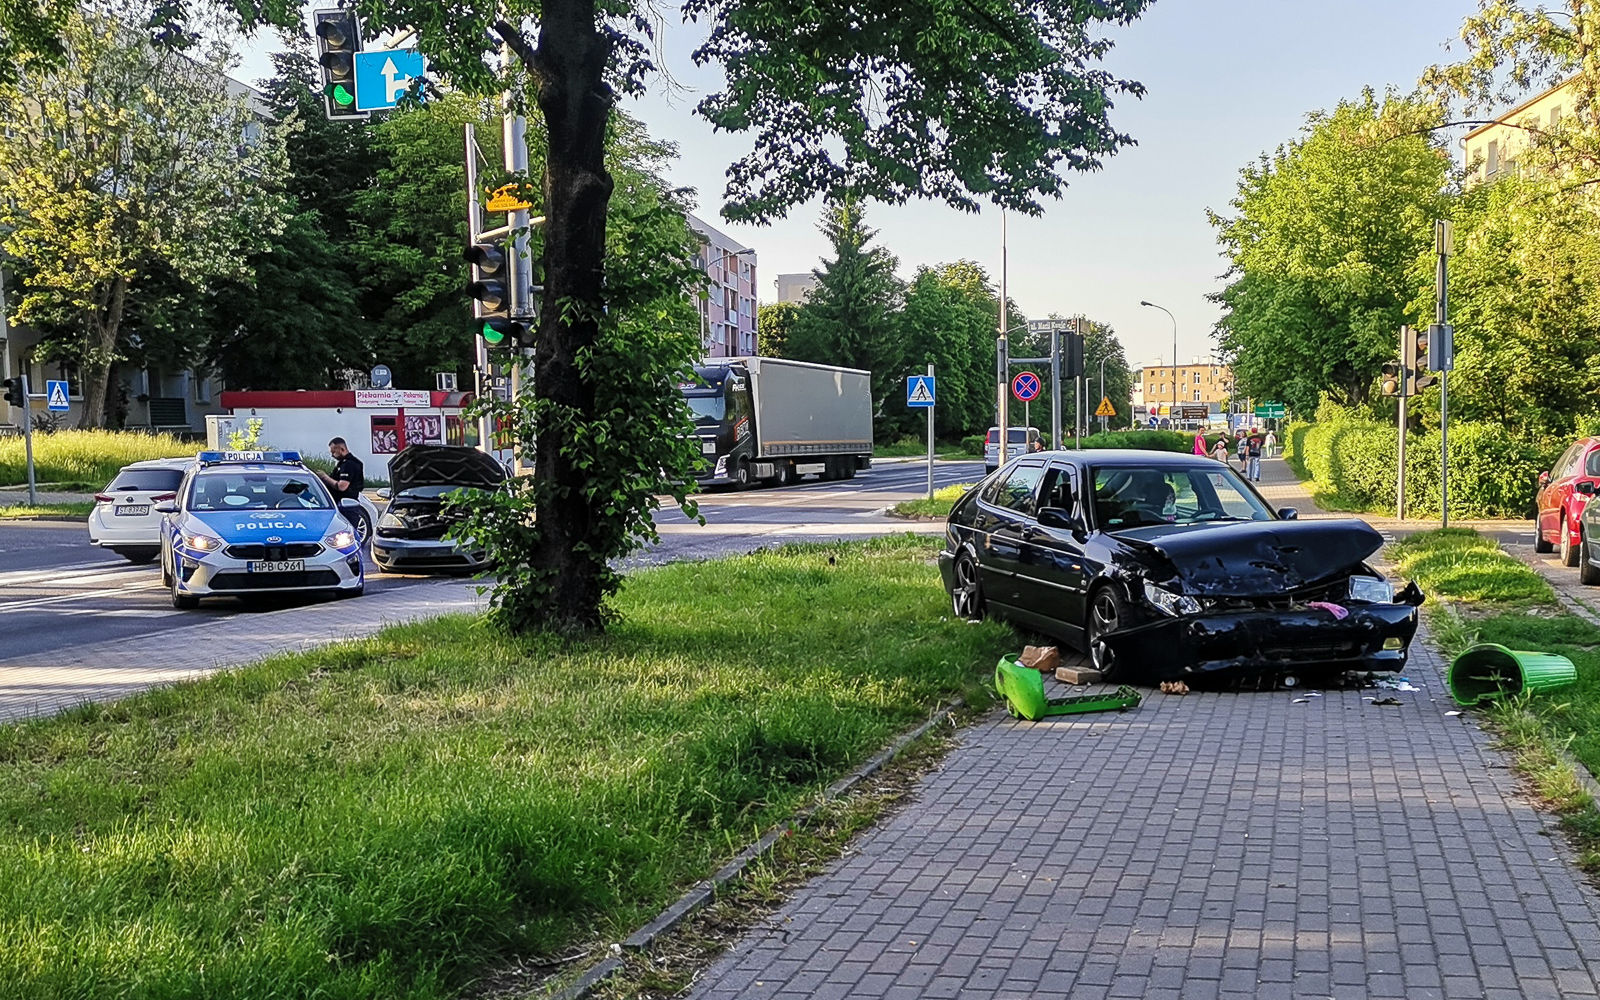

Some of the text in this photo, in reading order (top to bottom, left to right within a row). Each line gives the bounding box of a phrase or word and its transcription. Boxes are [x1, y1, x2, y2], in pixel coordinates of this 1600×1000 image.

[357, 391, 391, 399] Piekarnia
[235, 522, 307, 531] POLICJA
[254, 561, 301, 571] HPB C961
